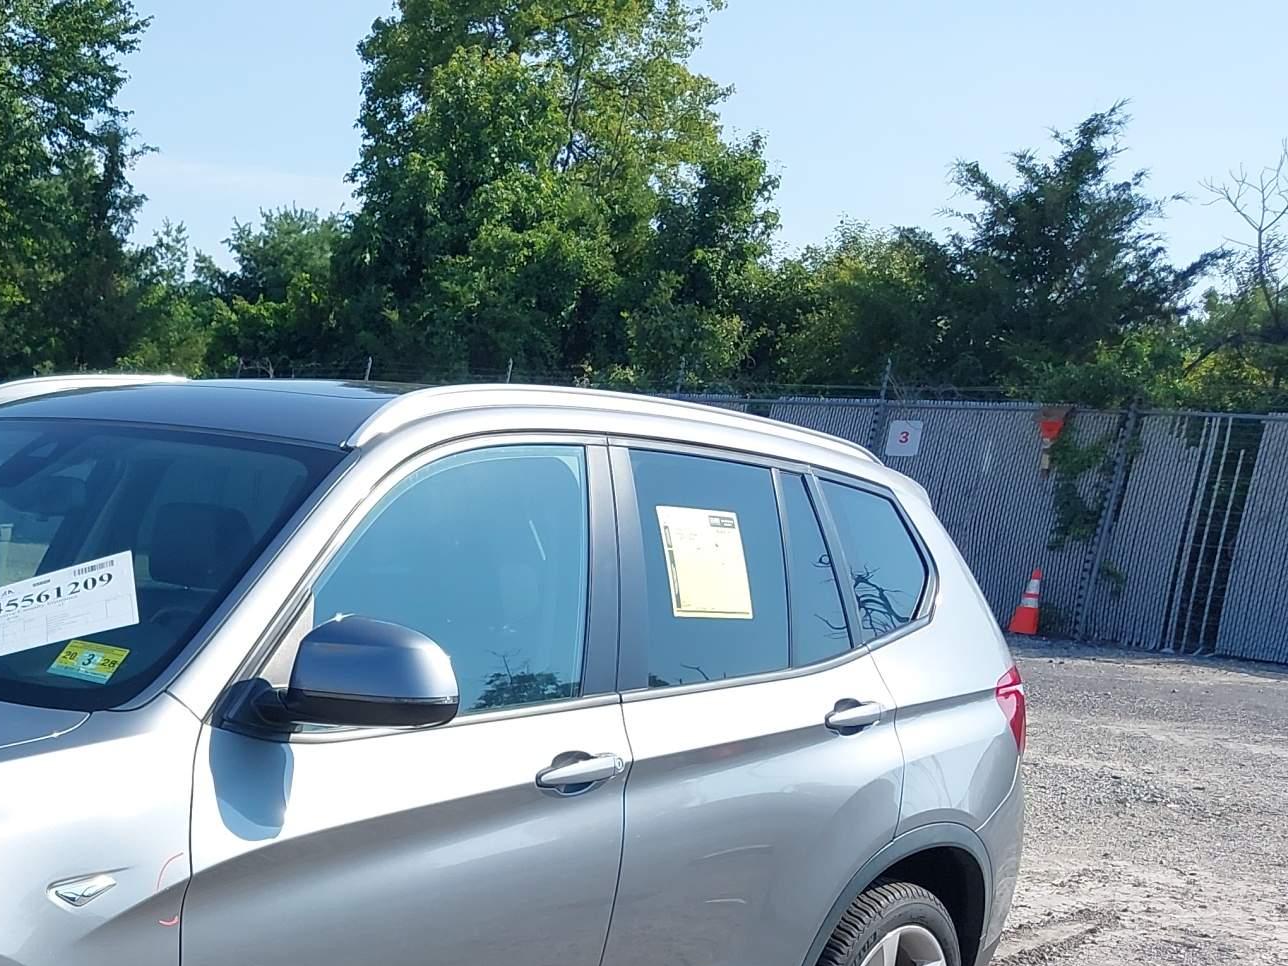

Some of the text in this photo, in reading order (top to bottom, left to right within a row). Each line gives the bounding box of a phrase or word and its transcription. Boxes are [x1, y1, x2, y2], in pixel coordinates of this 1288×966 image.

[899, 431, 910, 443] 3
[62, 650, 119, 668] 20 3 28
